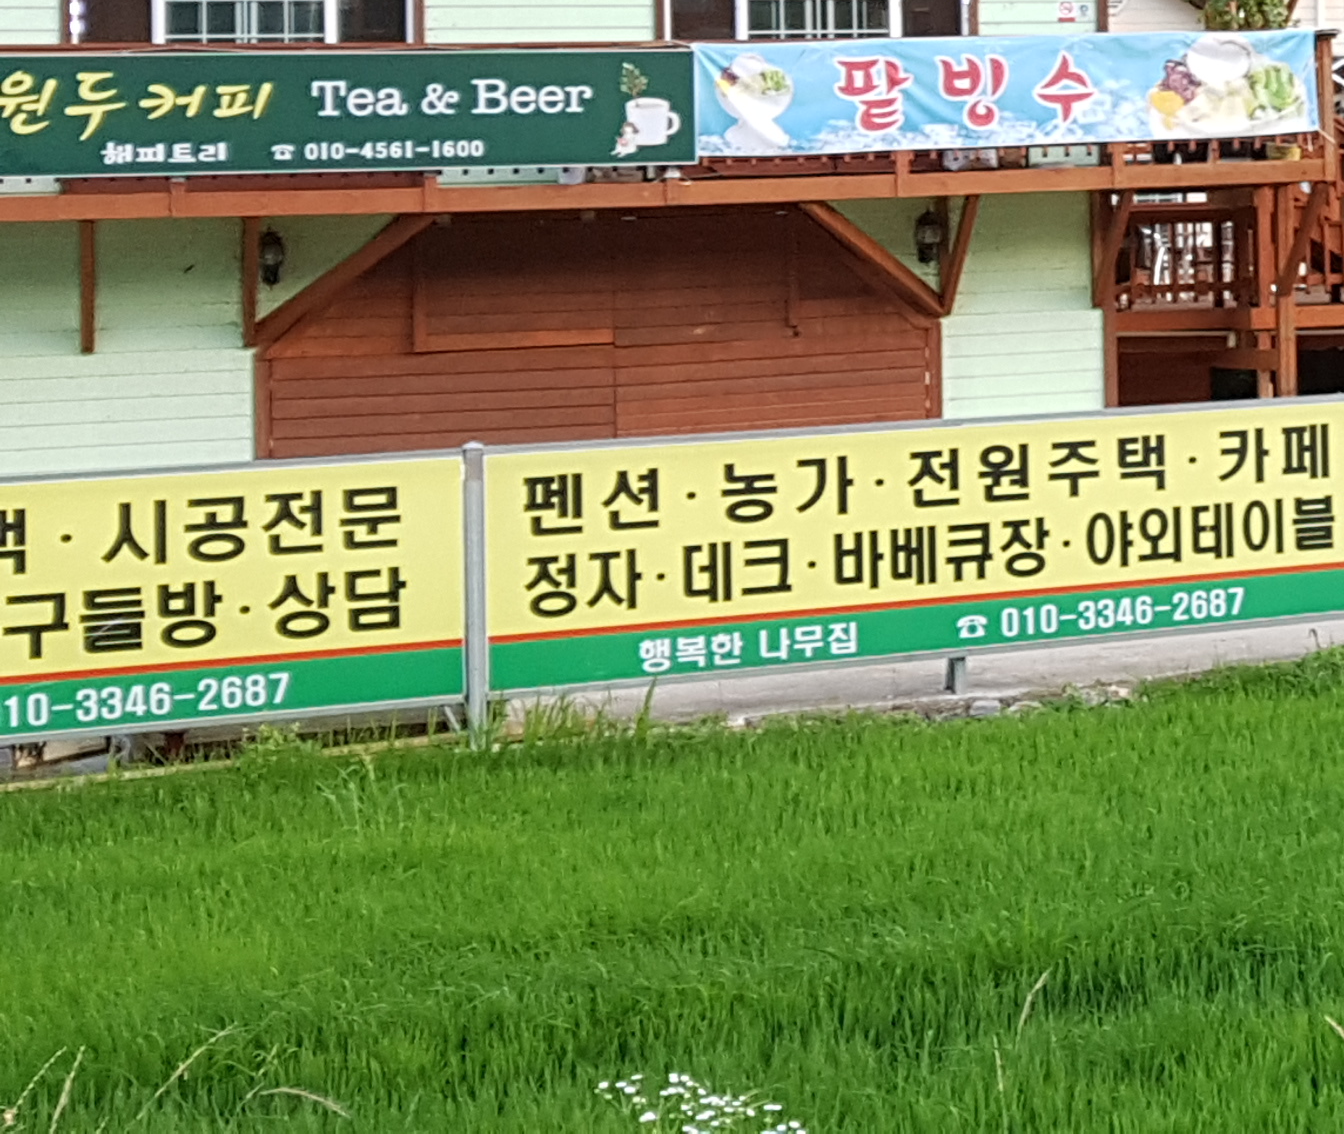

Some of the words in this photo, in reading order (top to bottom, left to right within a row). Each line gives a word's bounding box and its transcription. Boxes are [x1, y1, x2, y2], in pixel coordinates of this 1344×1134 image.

[311, 80, 409, 116] Tea
[421, 83, 460, 115] &
[470, 78, 593, 114] Beer
[100, 142, 229, 165] 해피트리
[304, 140, 485, 160] 010-4561-1600
[101, 486, 401, 565] 시공전문
[638, 632, 743, 673] 행복한
[759, 621, 859, 662] 나무집
[1001, 588, 1245, 638] 010-3346-2687
[4, 672, 290, 728] 10-3346-2687
